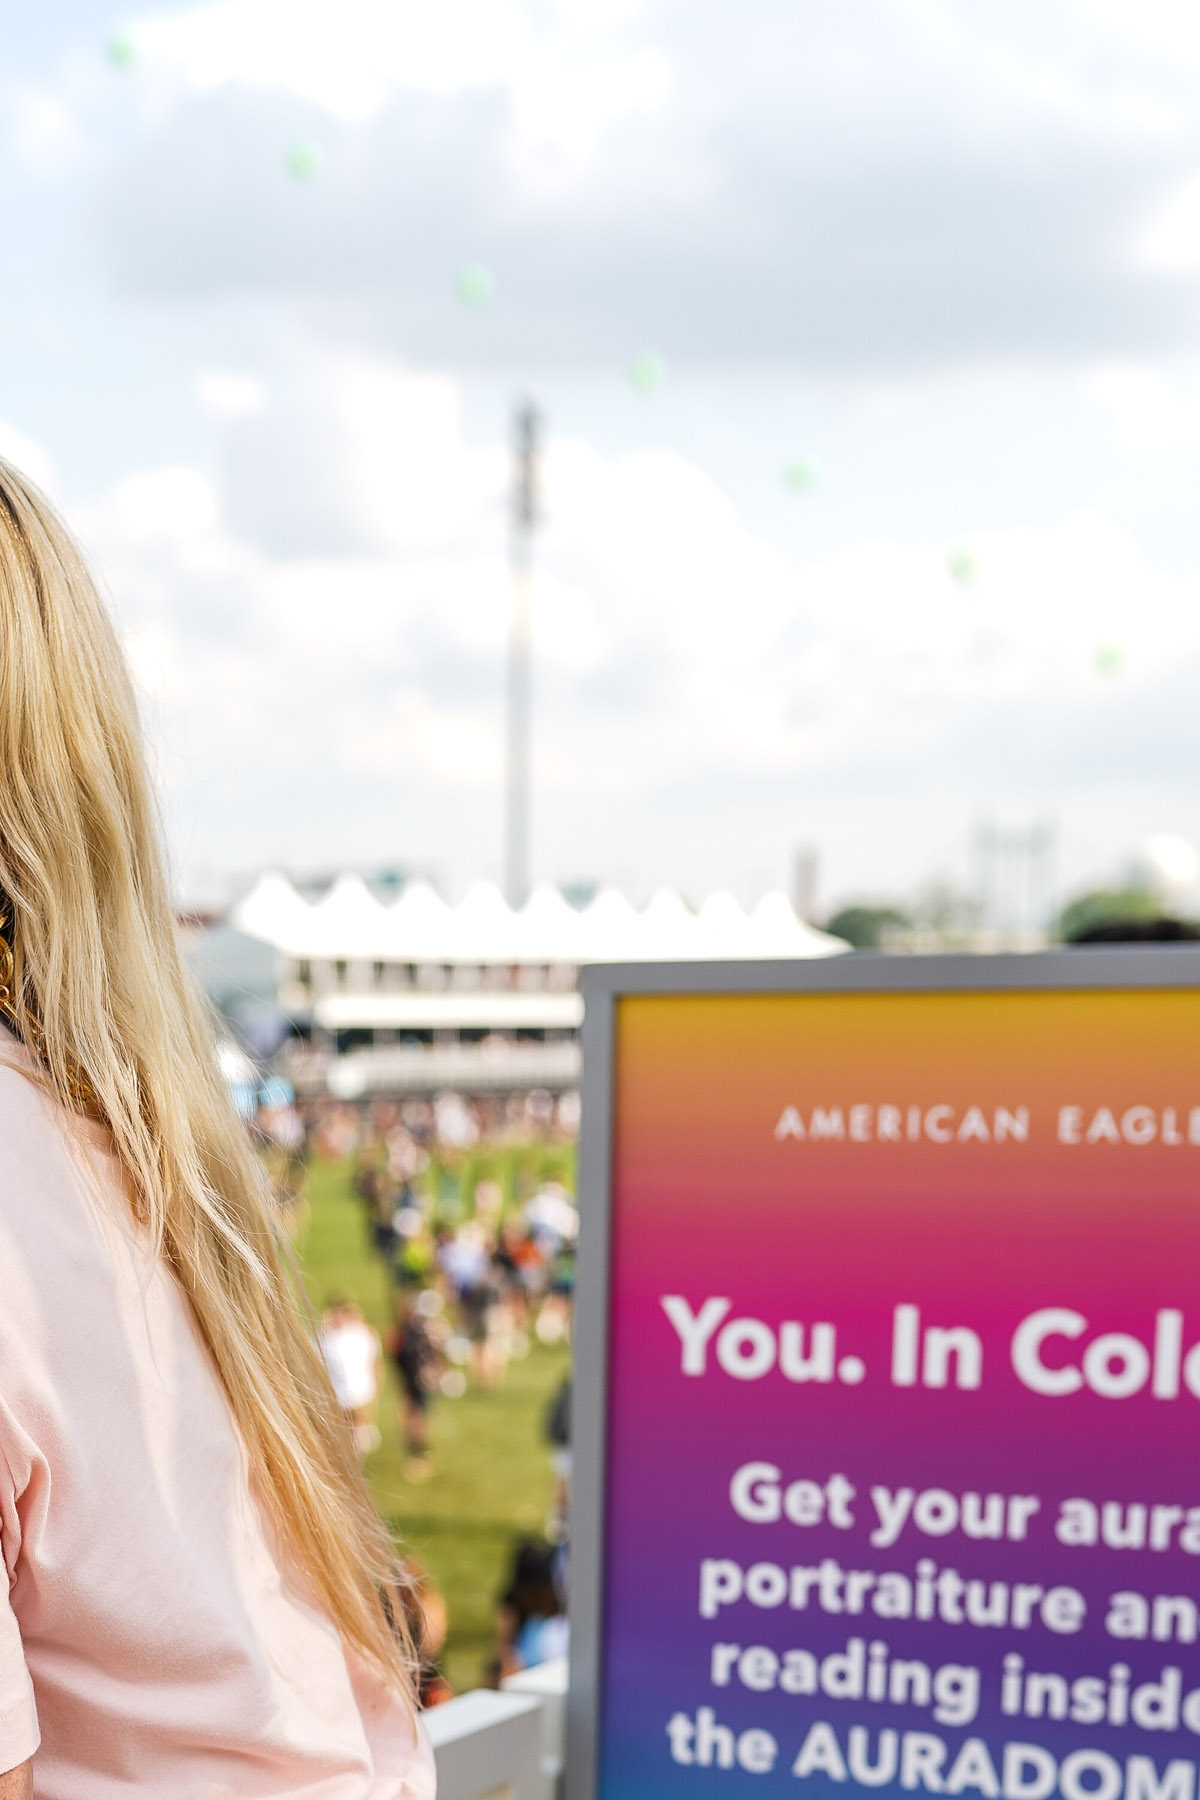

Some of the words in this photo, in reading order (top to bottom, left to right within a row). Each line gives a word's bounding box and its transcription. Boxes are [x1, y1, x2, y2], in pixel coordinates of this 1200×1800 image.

[775, 1104, 1029, 1143] AMERICAN
[660, 1294, 866, 1385] You.
[890, 1303, 983, 1391] In
[729, 1461, 856, 1529] Get
[869, 1485, 1041, 1548] your
[699, 1558, 1087, 1634] portraiture
[1105, 1591, 1200, 1645] an
[711, 1637, 981, 1727] reading
[667, 1706, 778, 1774] the
